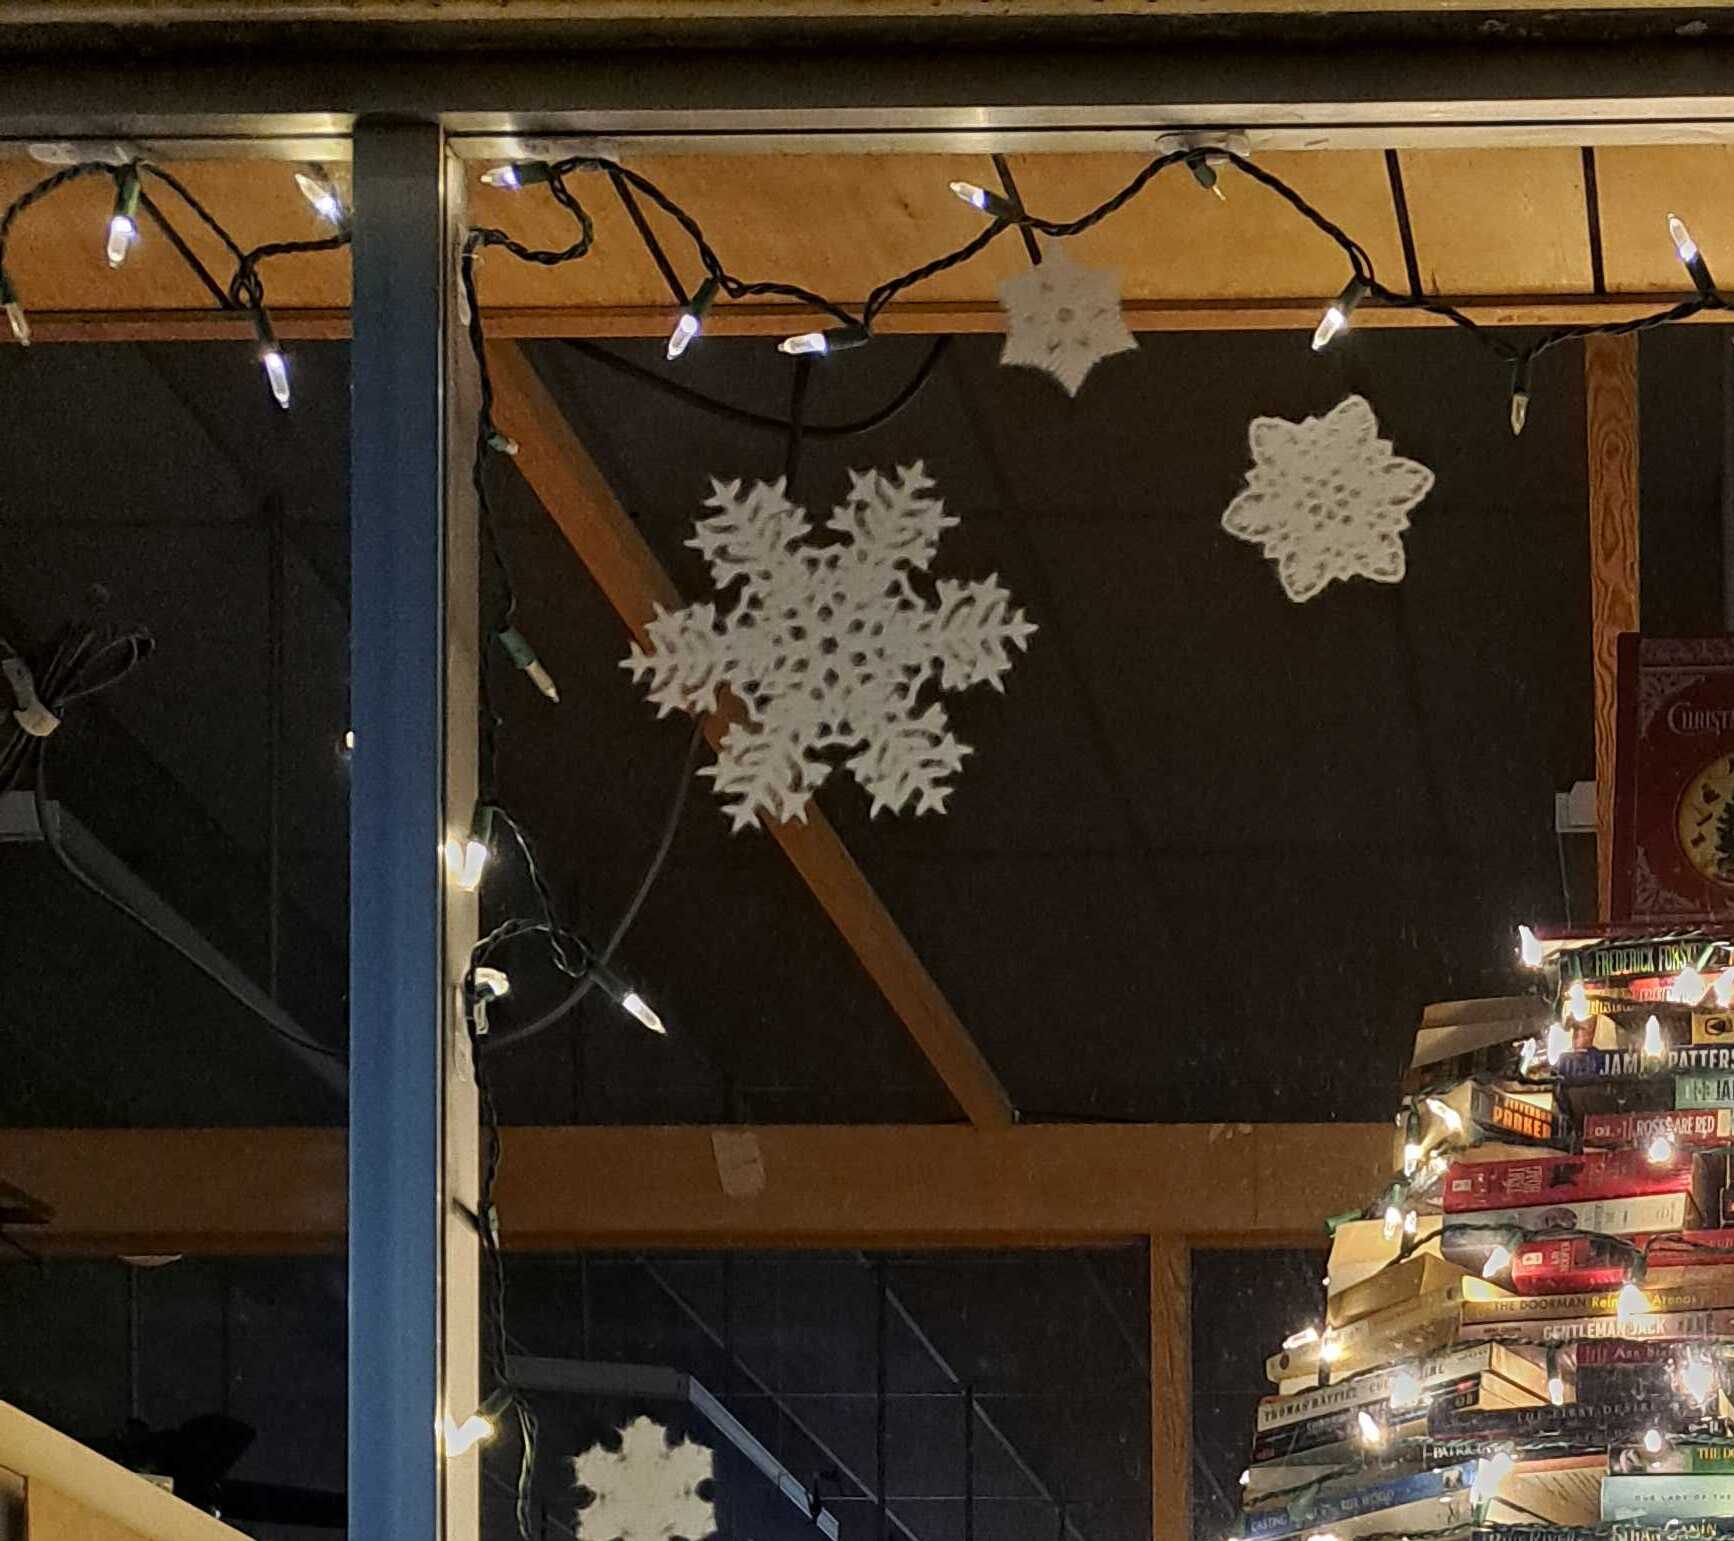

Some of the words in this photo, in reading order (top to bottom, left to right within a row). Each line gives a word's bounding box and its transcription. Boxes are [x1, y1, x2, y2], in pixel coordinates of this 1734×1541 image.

[1595, 947, 1655, 977] FREDERICK
[1492, 1104, 1552, 1139] PARKER
[1519, 1297, 1587, 1311] DOORMAN
[1543, 1320, 1626, 1340] GENTLEMAN
[1629, 1320, 1665, 1336] JACK
